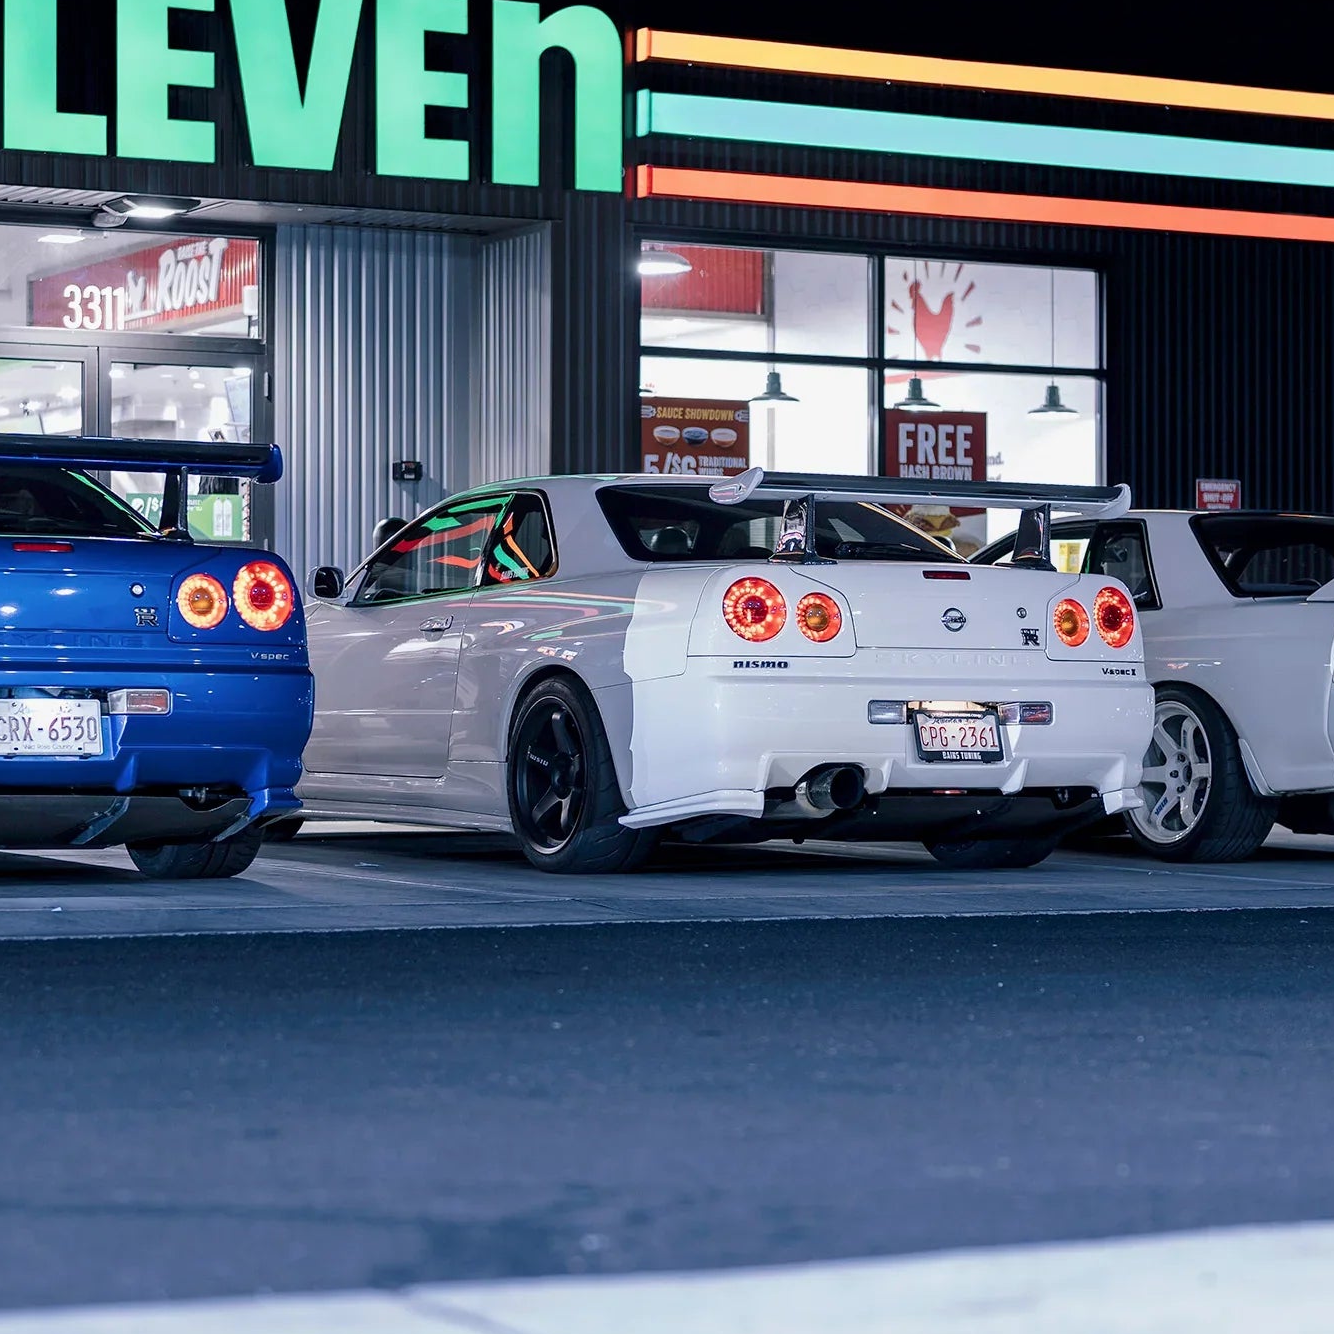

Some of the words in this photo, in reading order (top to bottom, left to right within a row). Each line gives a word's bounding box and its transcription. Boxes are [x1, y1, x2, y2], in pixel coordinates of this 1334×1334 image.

[63, 284, 125, 331] 3311
[656, 406, 684, 420] SAUCE
[685, 408, 735, 421] SHOWDOWN
[898, 422, 974, 466] FREE
[899, 464, 930, 479] HASH
[932, 465, 973, 481] BROWN
[919, 725, 998, 748] CPG-2361
